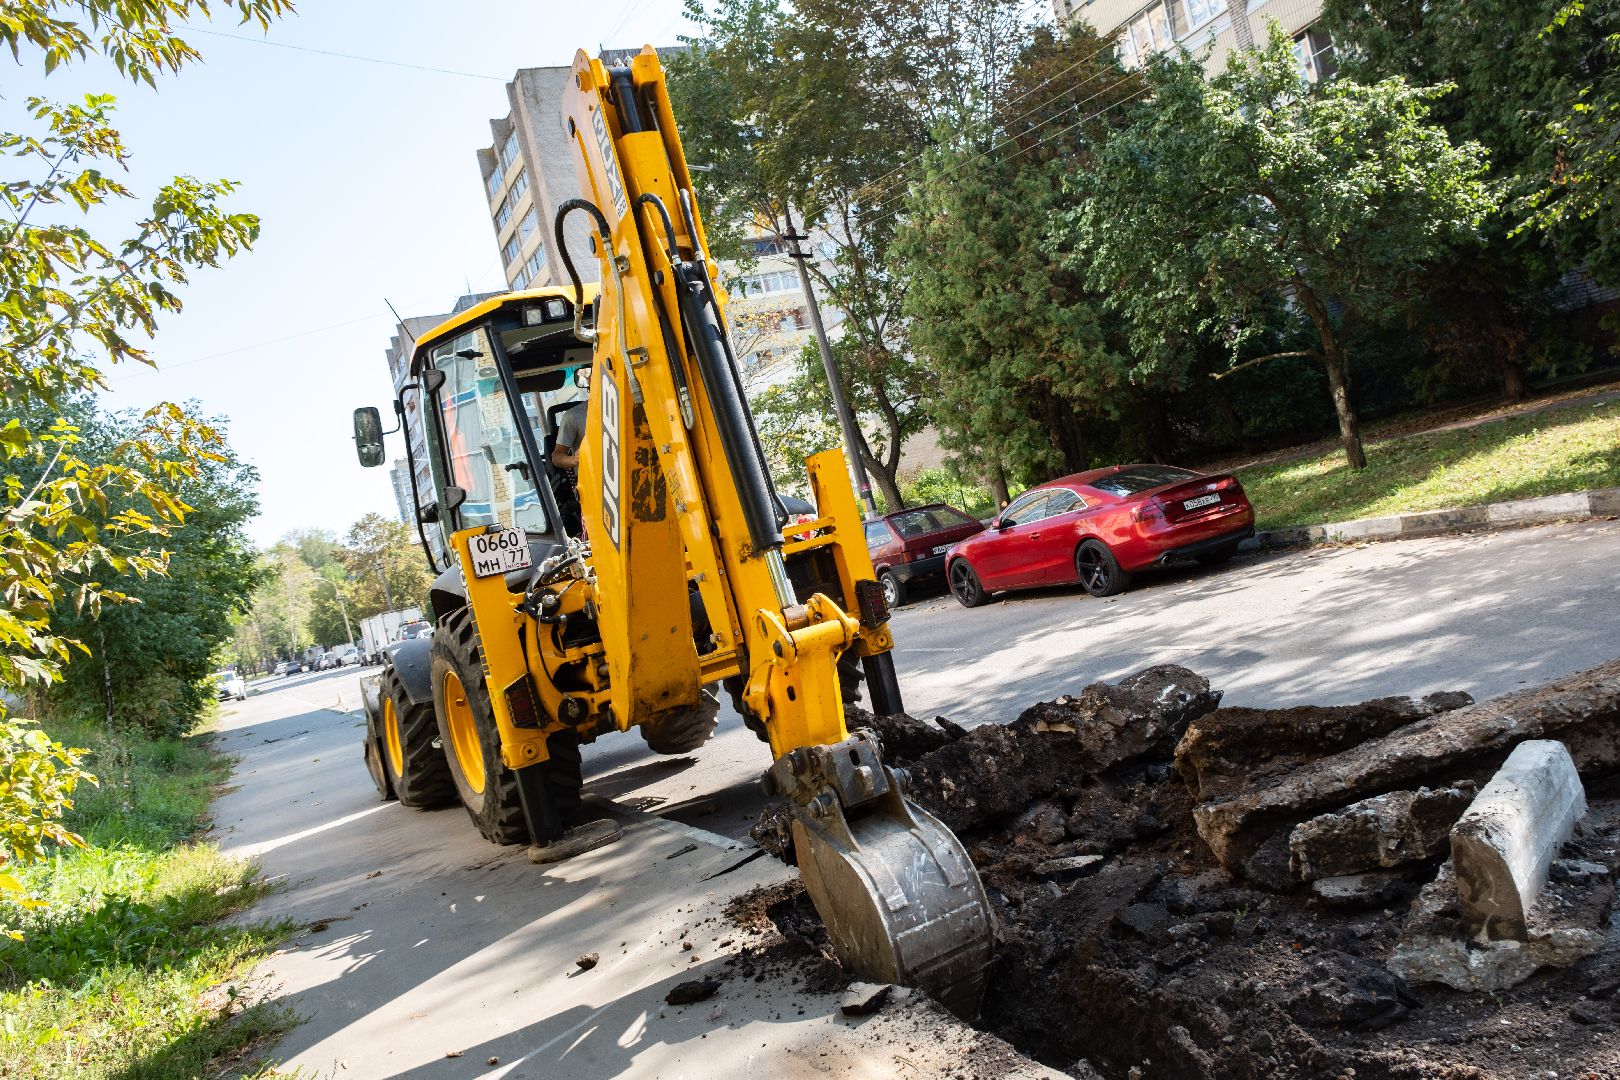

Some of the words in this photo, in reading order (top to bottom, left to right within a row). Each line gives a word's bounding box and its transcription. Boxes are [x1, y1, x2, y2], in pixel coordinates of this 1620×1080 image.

[601, 374, 619, 544] JCB
[476, 532, 518, 553] 0660
[508, 549, 524, 563] 77
